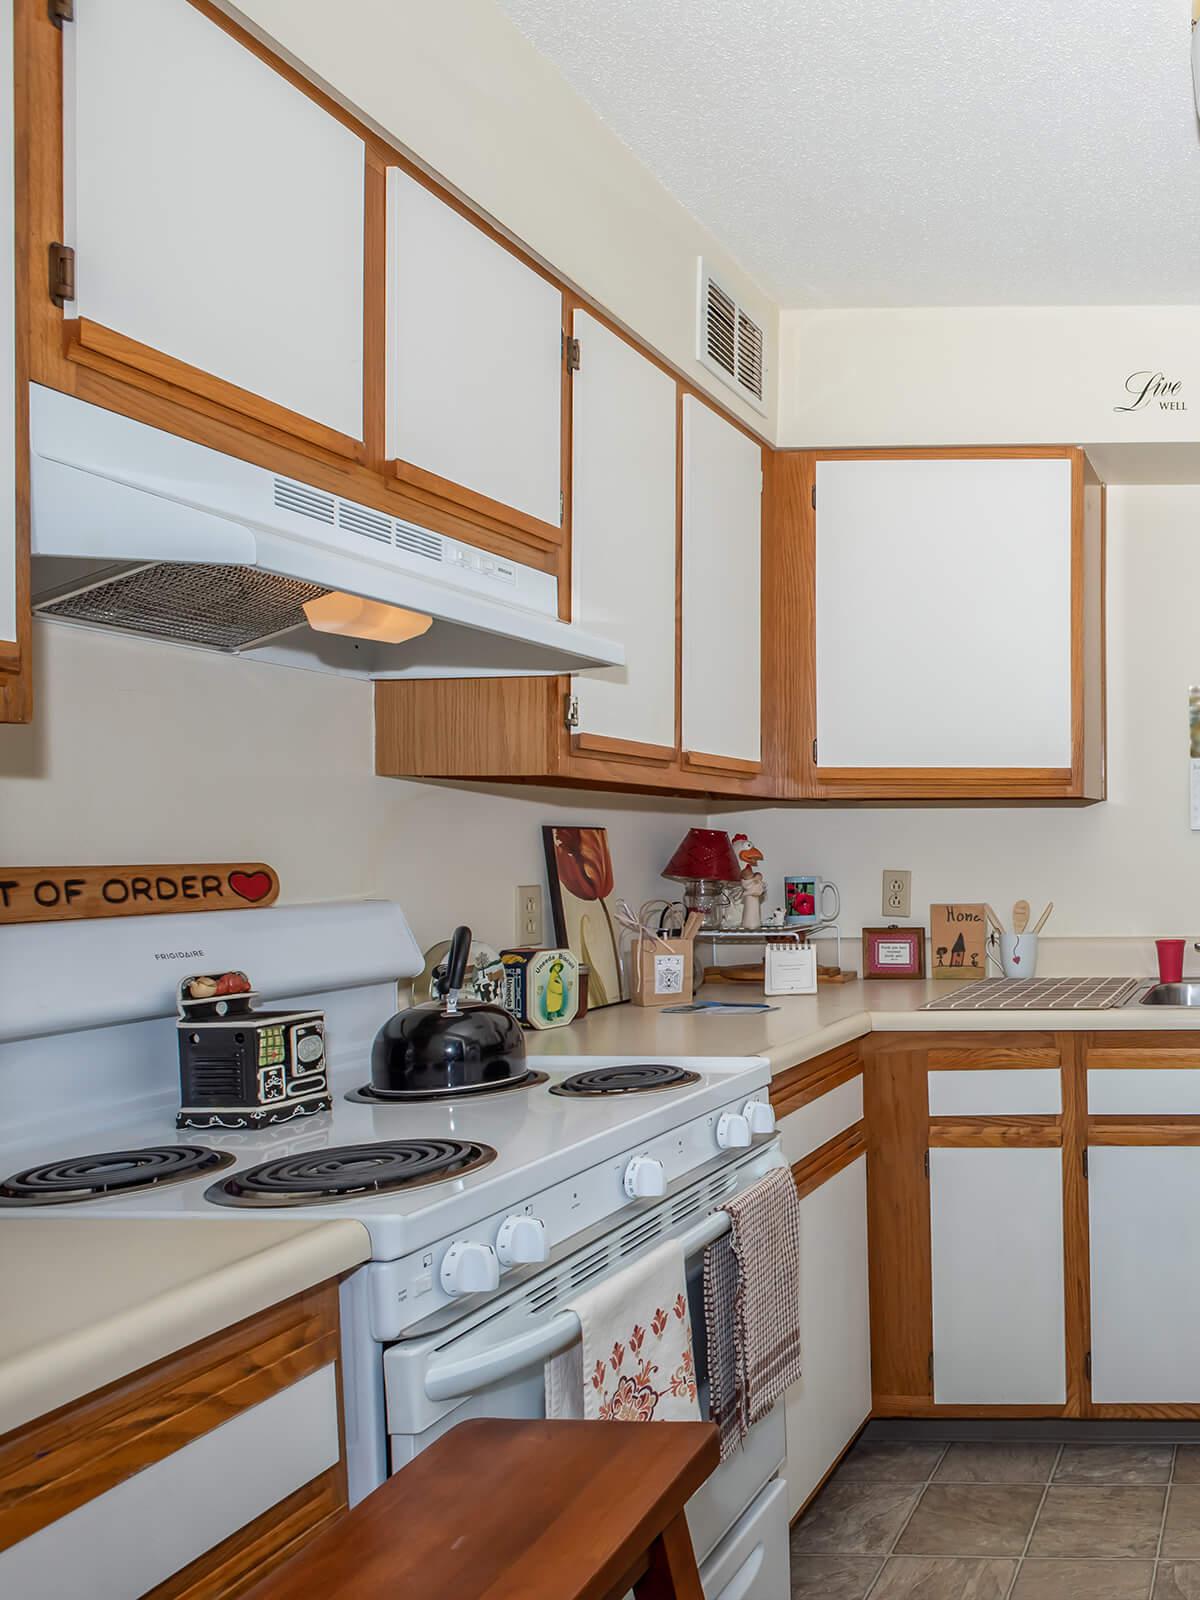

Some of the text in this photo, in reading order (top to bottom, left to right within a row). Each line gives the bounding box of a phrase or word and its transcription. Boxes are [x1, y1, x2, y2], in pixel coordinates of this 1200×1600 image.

[1113, 370, 1183, 412] Live
[1159, 401, 1188, 411] WELL
[34, 879, 87, 908] OF
[102, 875, 224, 905] ORDER
[154, 948, 205, 961] FRIGIDAIRE
[535, 954, 556, 975] Uneeda
